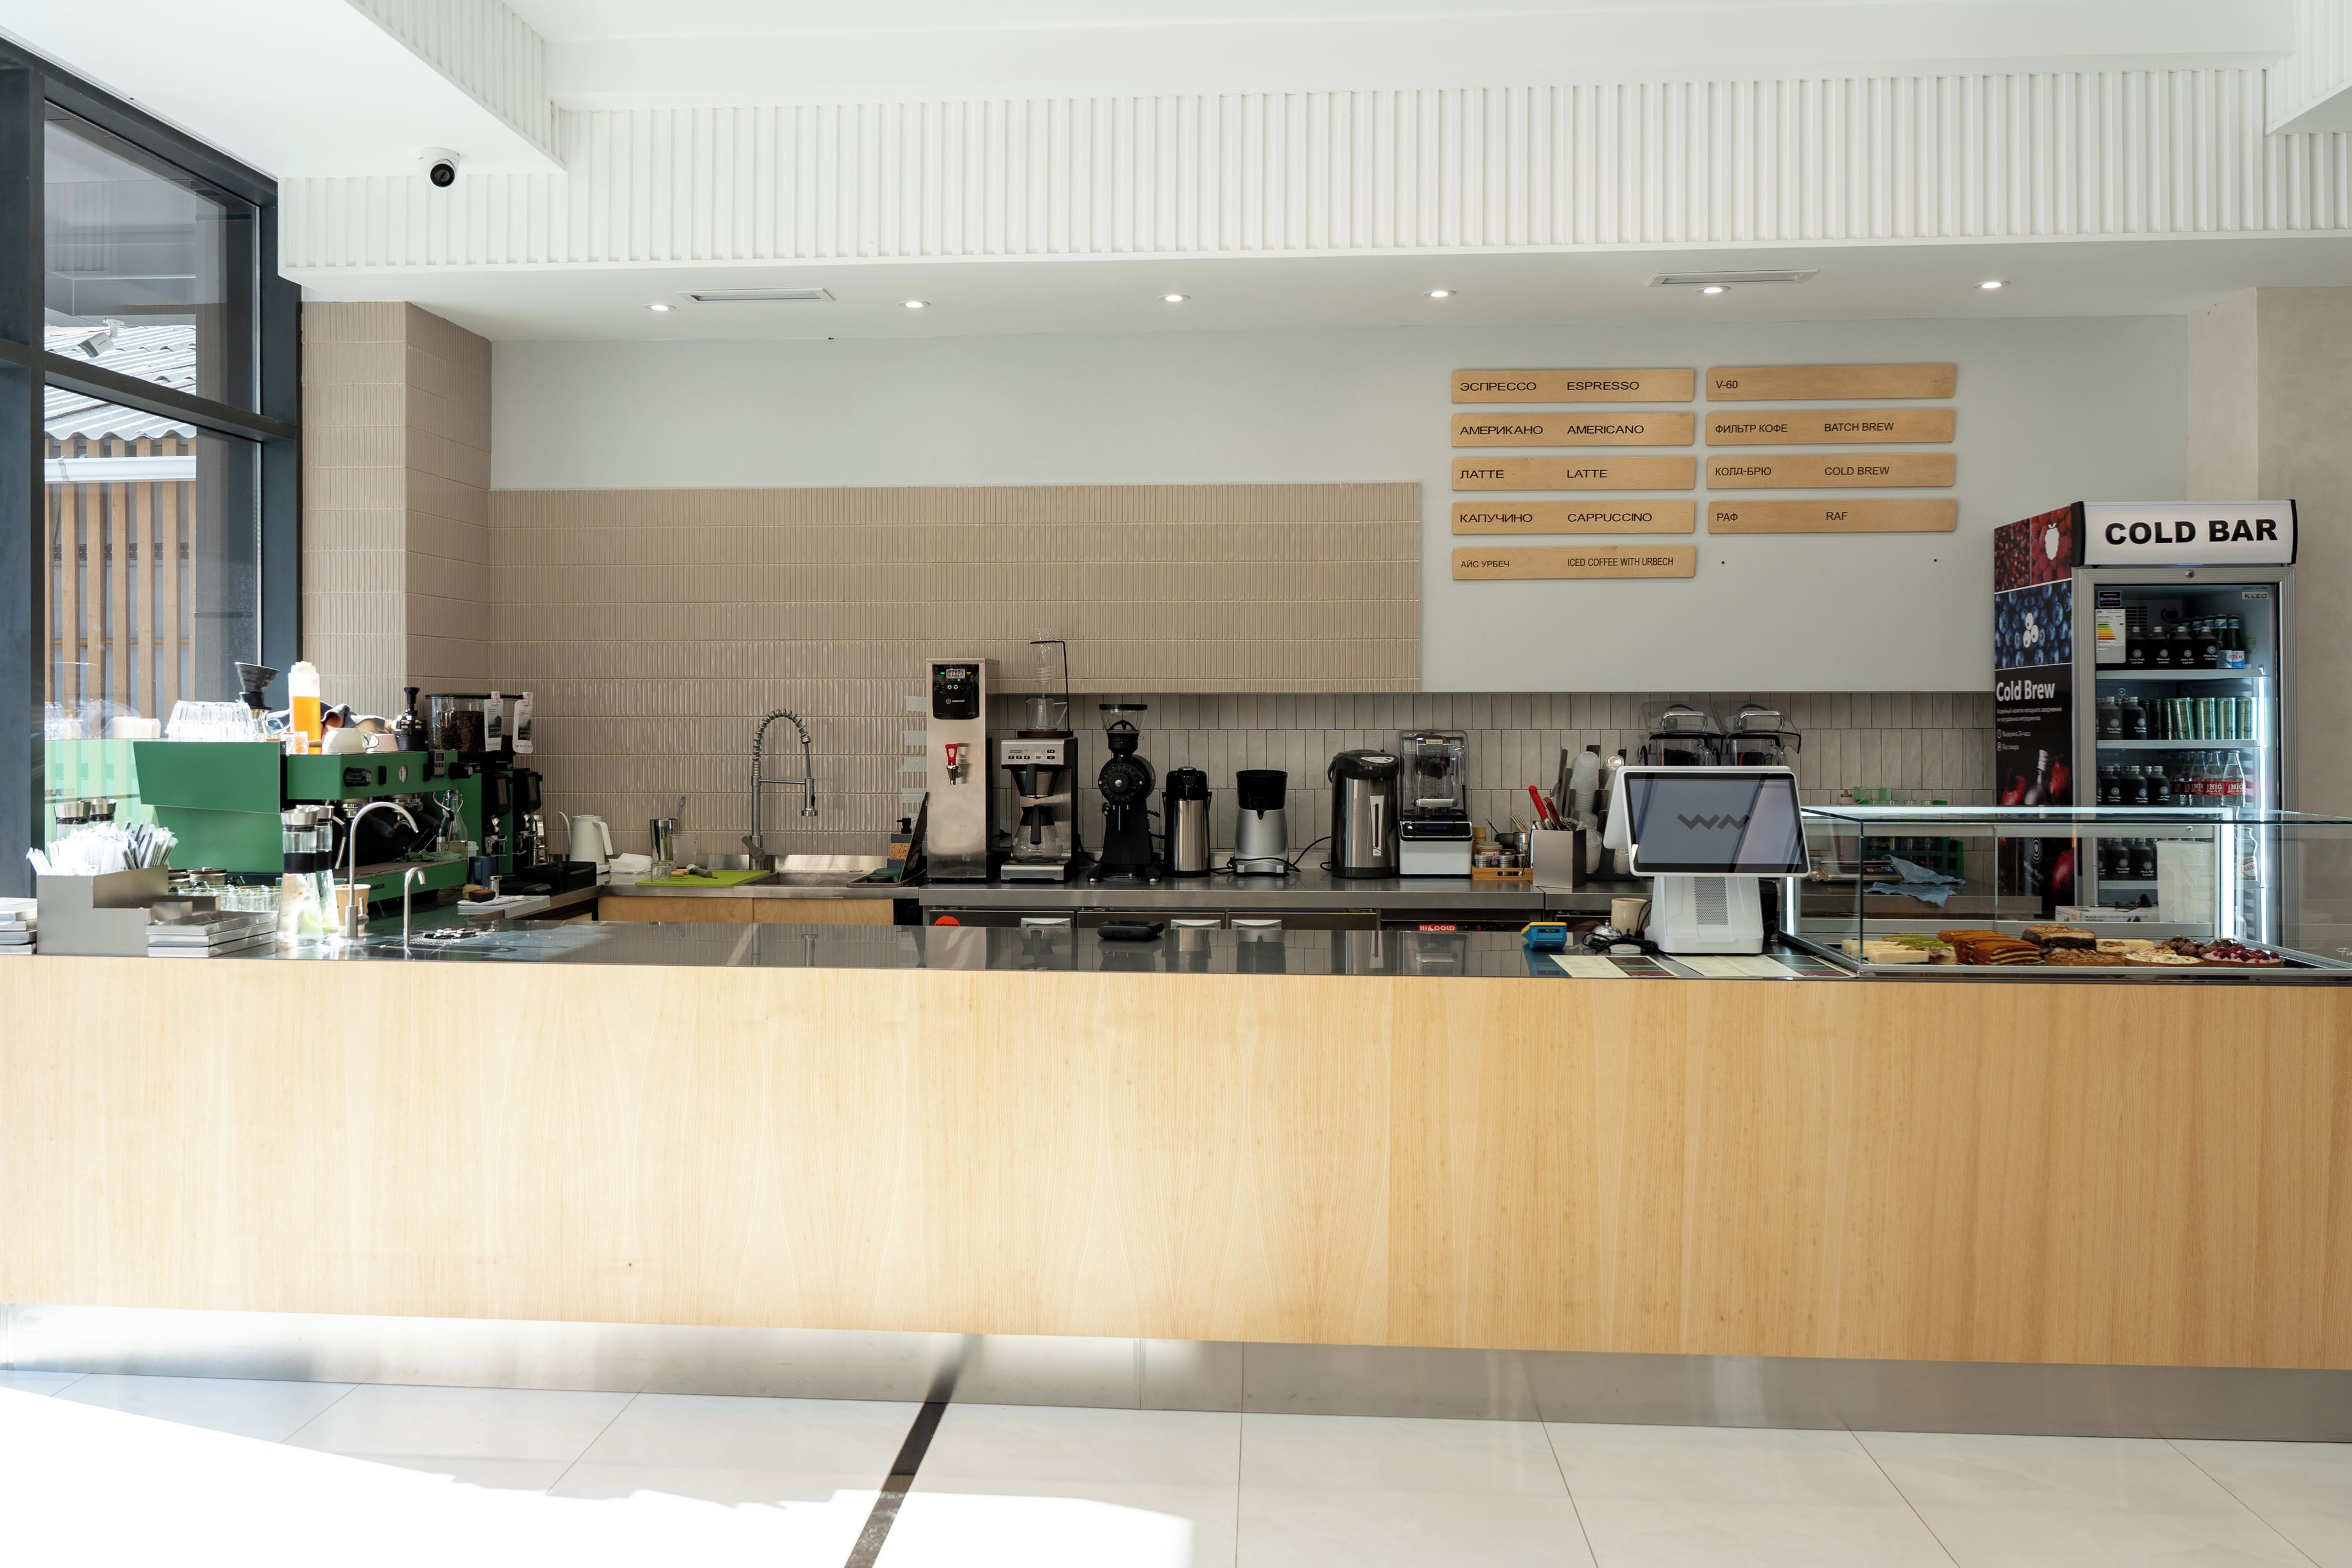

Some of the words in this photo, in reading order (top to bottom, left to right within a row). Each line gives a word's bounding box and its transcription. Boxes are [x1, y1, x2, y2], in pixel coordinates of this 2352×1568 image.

[1460, 382, 1537, 391] ЭСПРЕССО
[1567, 381, 1640, 391] ESPRESSO
[1716, 380, 1738, 389] V-60
[1460, 426, 1544, 435] АМЕРИКАНО
[1567, 425, 1645, 434] AMERICANO
[1715, 424, 1757, 434] ФИЛЬТР
[1758, 423, 1789, 433] КОФЕ
[1824, 422, 1860, 432] BATCH
[1861, 422, 1894, 432] BREW
[1460, 470, 1505, 479] ЛАТТЕ
[1567, 469, 1608, 478] LATTE
[1824, 467, 1855, 476] COLD
[1857, 466, 1890, 475] BREW
[1460, 513, 1533, 523] КАПУЧИНО
[1567, 513, 1653, 522] CAPPUCCINO
[1716, 513, 1738, 522] РАФ
[1825, 511, 1849, 521] RAF
[2105, 521, 2196, 545] COLD
[2208, 519, 2278, 542] BAR
[1460, 559, 1479, 568] АЙС
[1480, 559, 1510, 568] УРБЕЧ
[1567, 557, 1586, 567] ICED
[1588, 557, 1618, 567] COFFEE
[1620, 557, 1640, 567] WITH
[1642, 557, 1674, 567] URBECH
[1996, 680, 2022, 702] Cold
[2024, 679, 2056, 699] Brew
